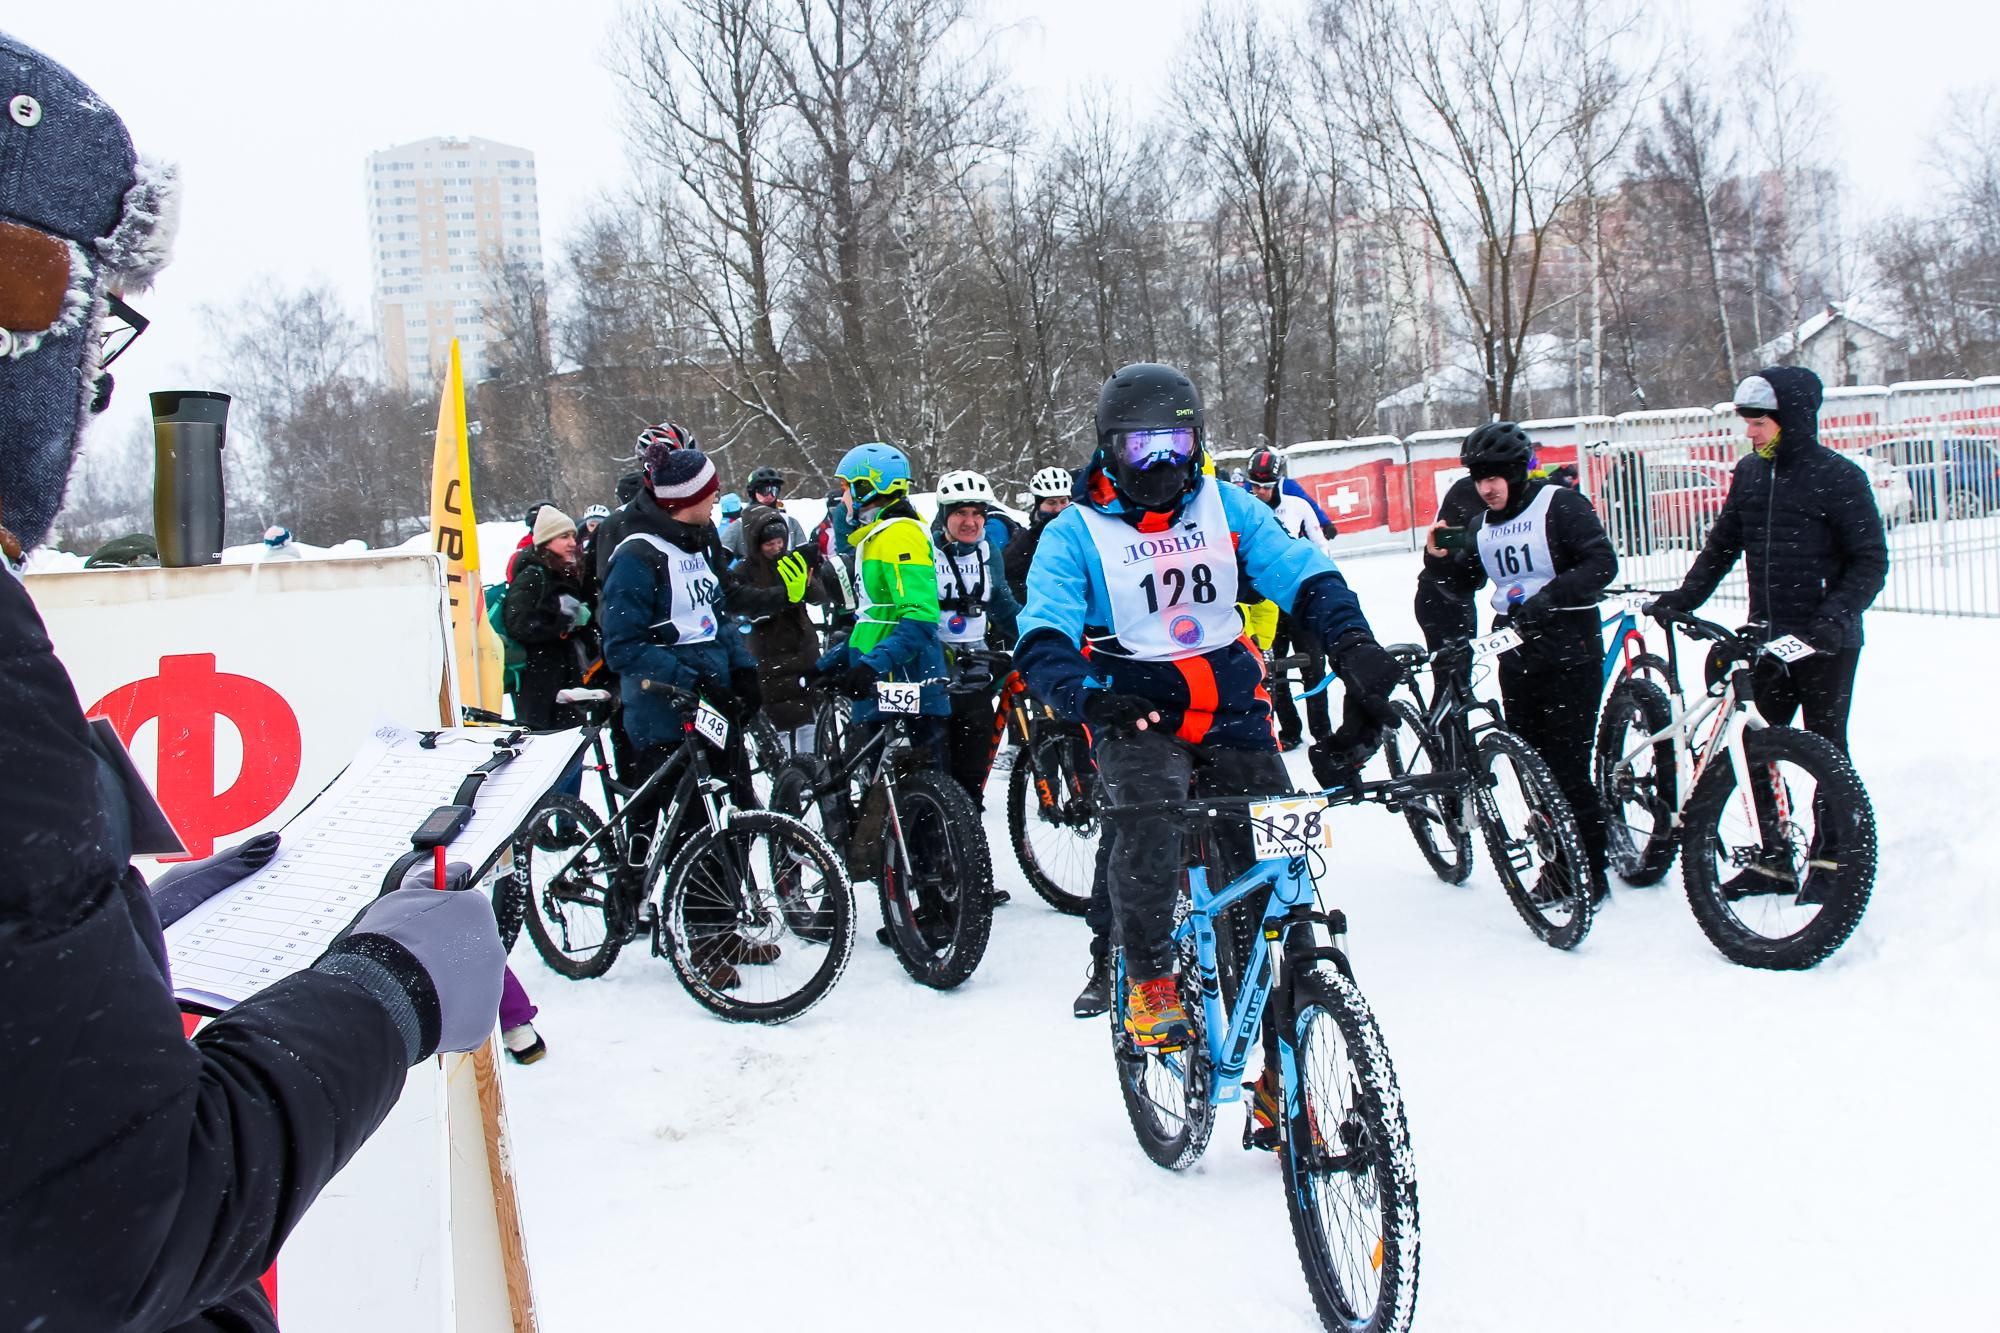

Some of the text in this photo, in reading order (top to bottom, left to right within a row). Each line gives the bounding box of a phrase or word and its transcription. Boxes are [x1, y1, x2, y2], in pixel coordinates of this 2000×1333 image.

[1175, 408, 1194, 417] SMITH
[1123, 531, 1208, 564] ЛОБНЯ
[1494, 543, 1534, 578] 161
[1139, 563, 1217, 614] 128
[1478, 635, 1510, 652] 161
[1773, 640, 1803, 657] 325
[883, 689, 914, 705] 156
[701, 709, 725, 737] 148
[86, 652, 302, 863] Ф
[1262, 811, 1322, 843] 128
[1278, 1072, 1288, 1143] STELS
